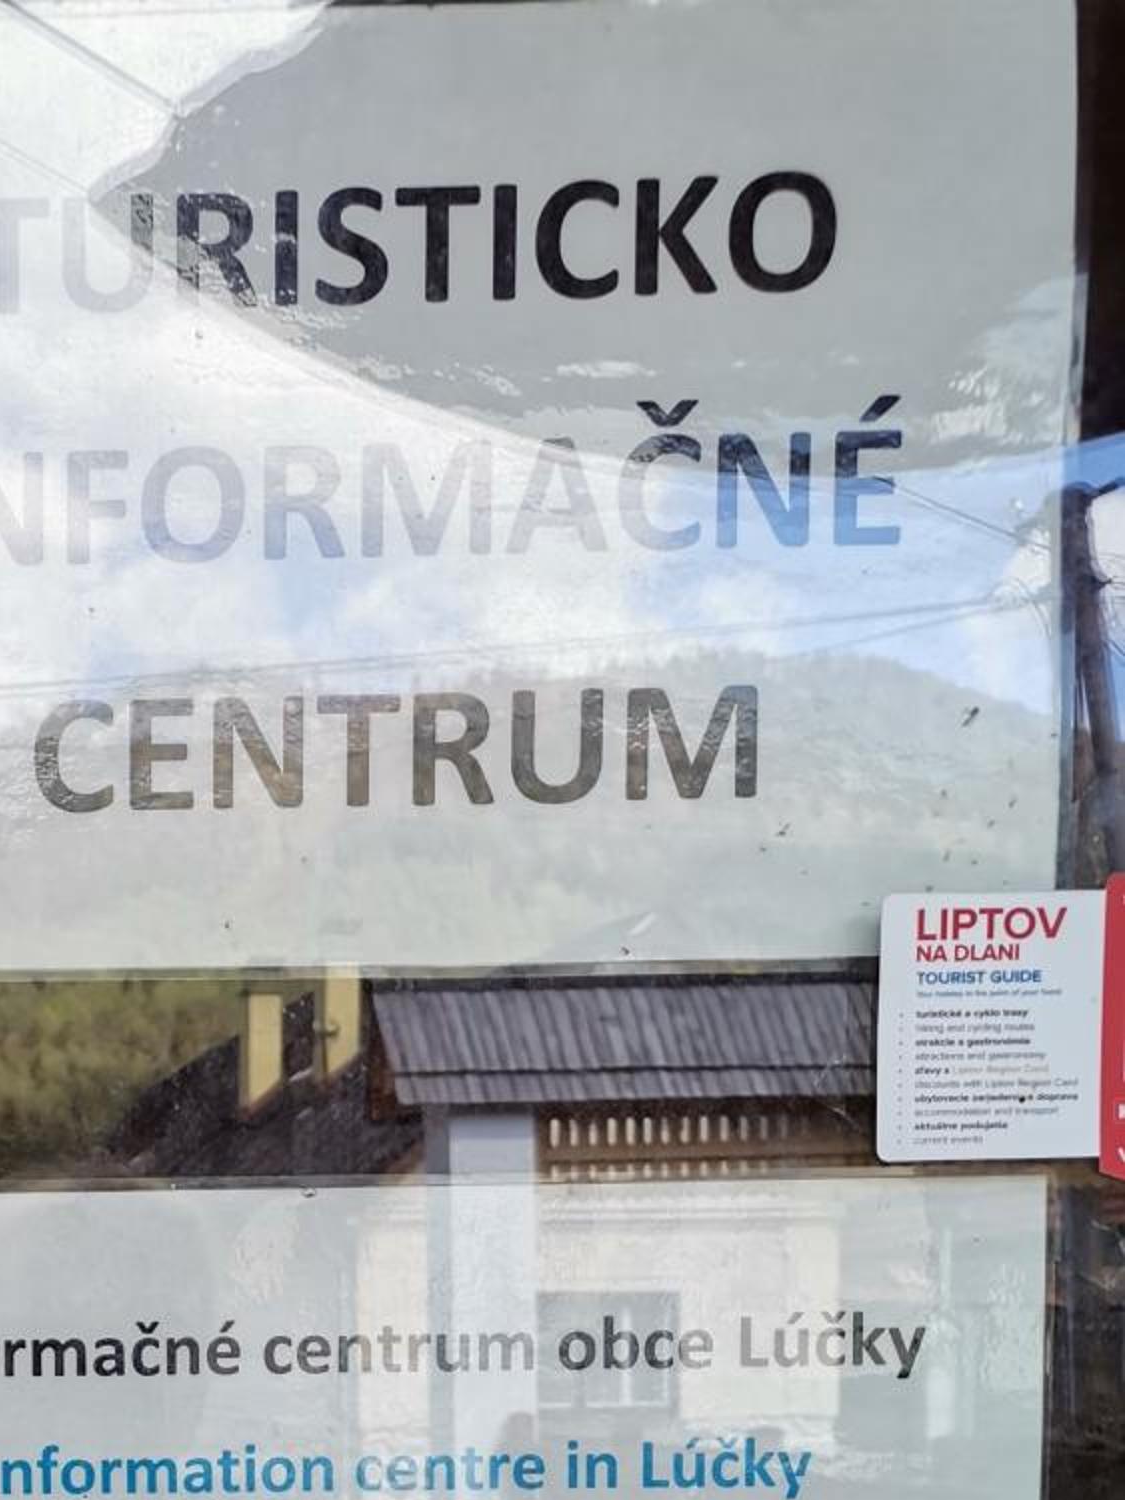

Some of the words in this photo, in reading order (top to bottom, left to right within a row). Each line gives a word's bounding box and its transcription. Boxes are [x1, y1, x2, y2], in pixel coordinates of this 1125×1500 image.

[33, 684, 760, 814] CENTRUM
[916, 905, 1069, 941] LIPTOV
[915, 945, 948, 963] NA
[954, 943, 1021, 962] DLANI
[916, 971, 986, 986] TOURIST
[989, 969, 1043, 984] GUIDE
[262, 1325, 535, 1376] centrum
[558, 1315, 714, 1373] obce
[739, 1310, 927, 1380] Lúčky
[355, 1446, 546, 1492] centre
[566, 1440, 619, 1490] in
[641, 1437, 812, 1500] Lúčky
